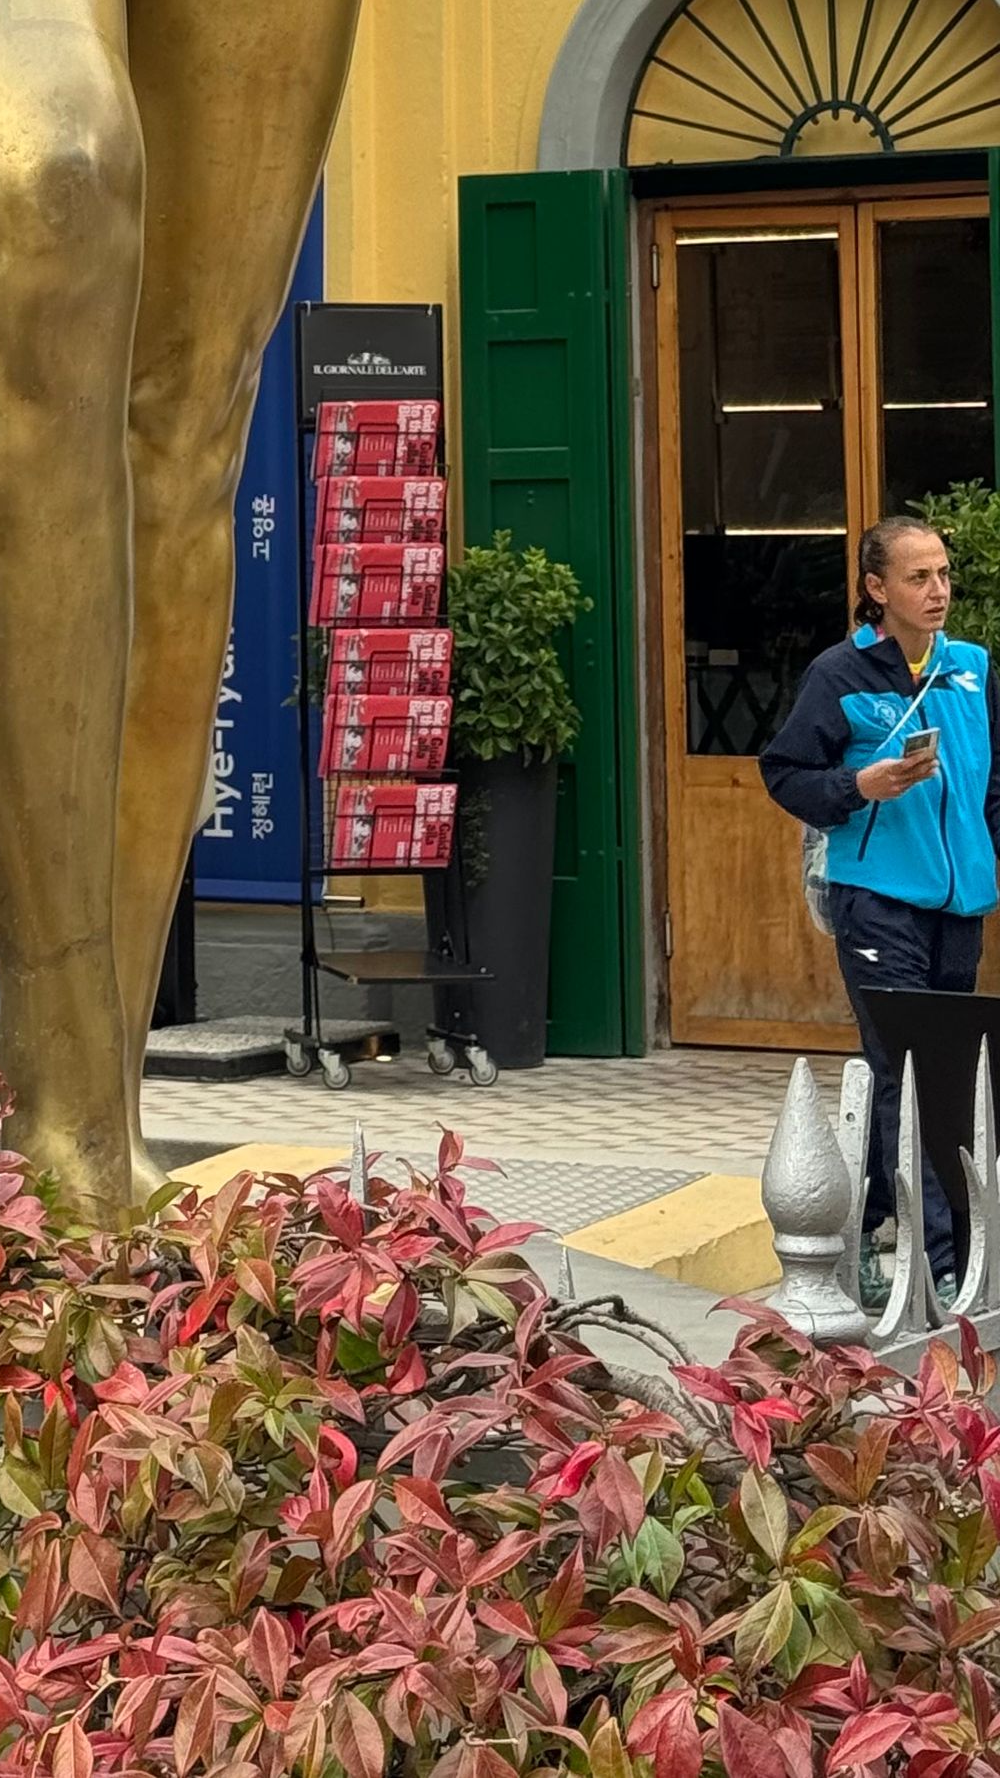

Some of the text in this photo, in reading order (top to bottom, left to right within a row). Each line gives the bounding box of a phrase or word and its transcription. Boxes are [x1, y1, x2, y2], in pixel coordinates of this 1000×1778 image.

[323, 365, 374, 375] GIORNALE
[252, 494, 275, 562] 고영훈
[252, 773, 274, 840] 정혜련
